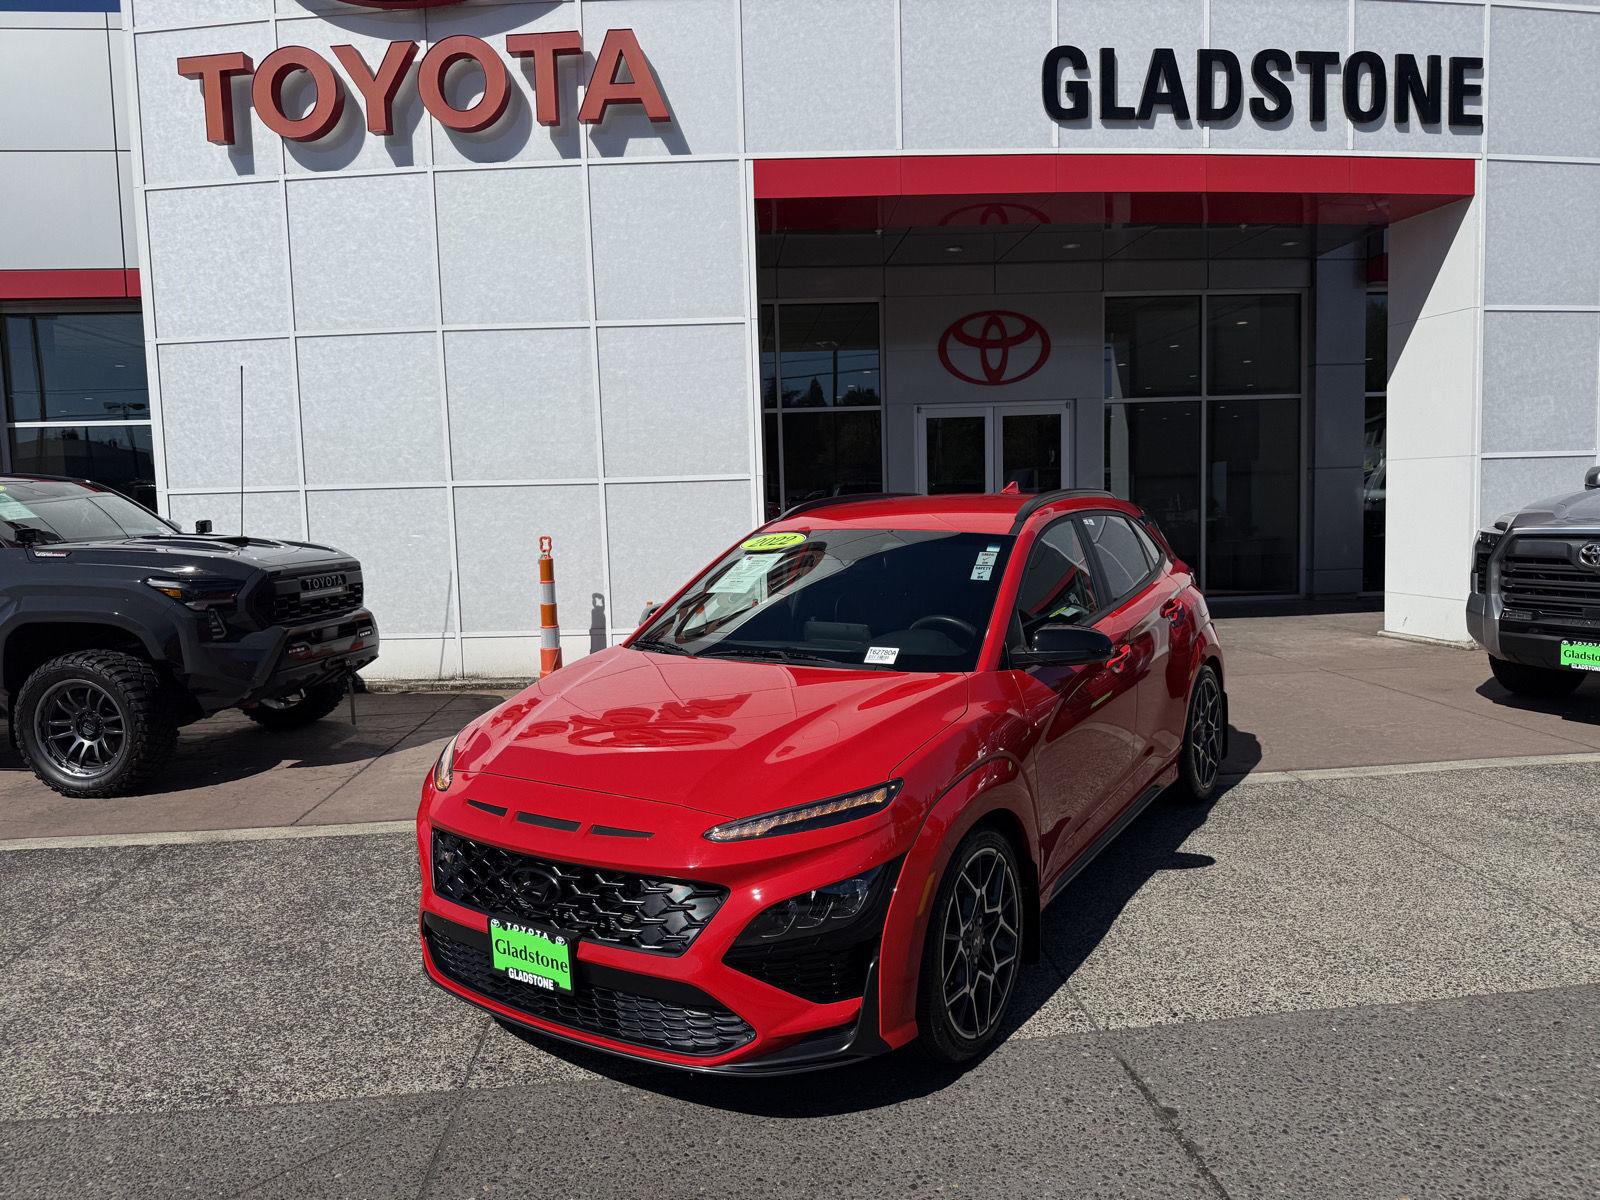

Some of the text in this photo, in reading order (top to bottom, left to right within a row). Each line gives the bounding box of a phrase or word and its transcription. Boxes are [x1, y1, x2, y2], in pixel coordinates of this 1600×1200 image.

[177, 28, 670, 146] TOYOTA
[1042, 45, 1484, 127] GLADSTONE
[747, 536, 797, 548] 2022
[306, 575, 344, 590] TOYOTA
[506, 922, 549, 941] TOYOTA
[494, 938, 569, 974] Gladstone
[508, 967, 555, 991] GLADSTONE
